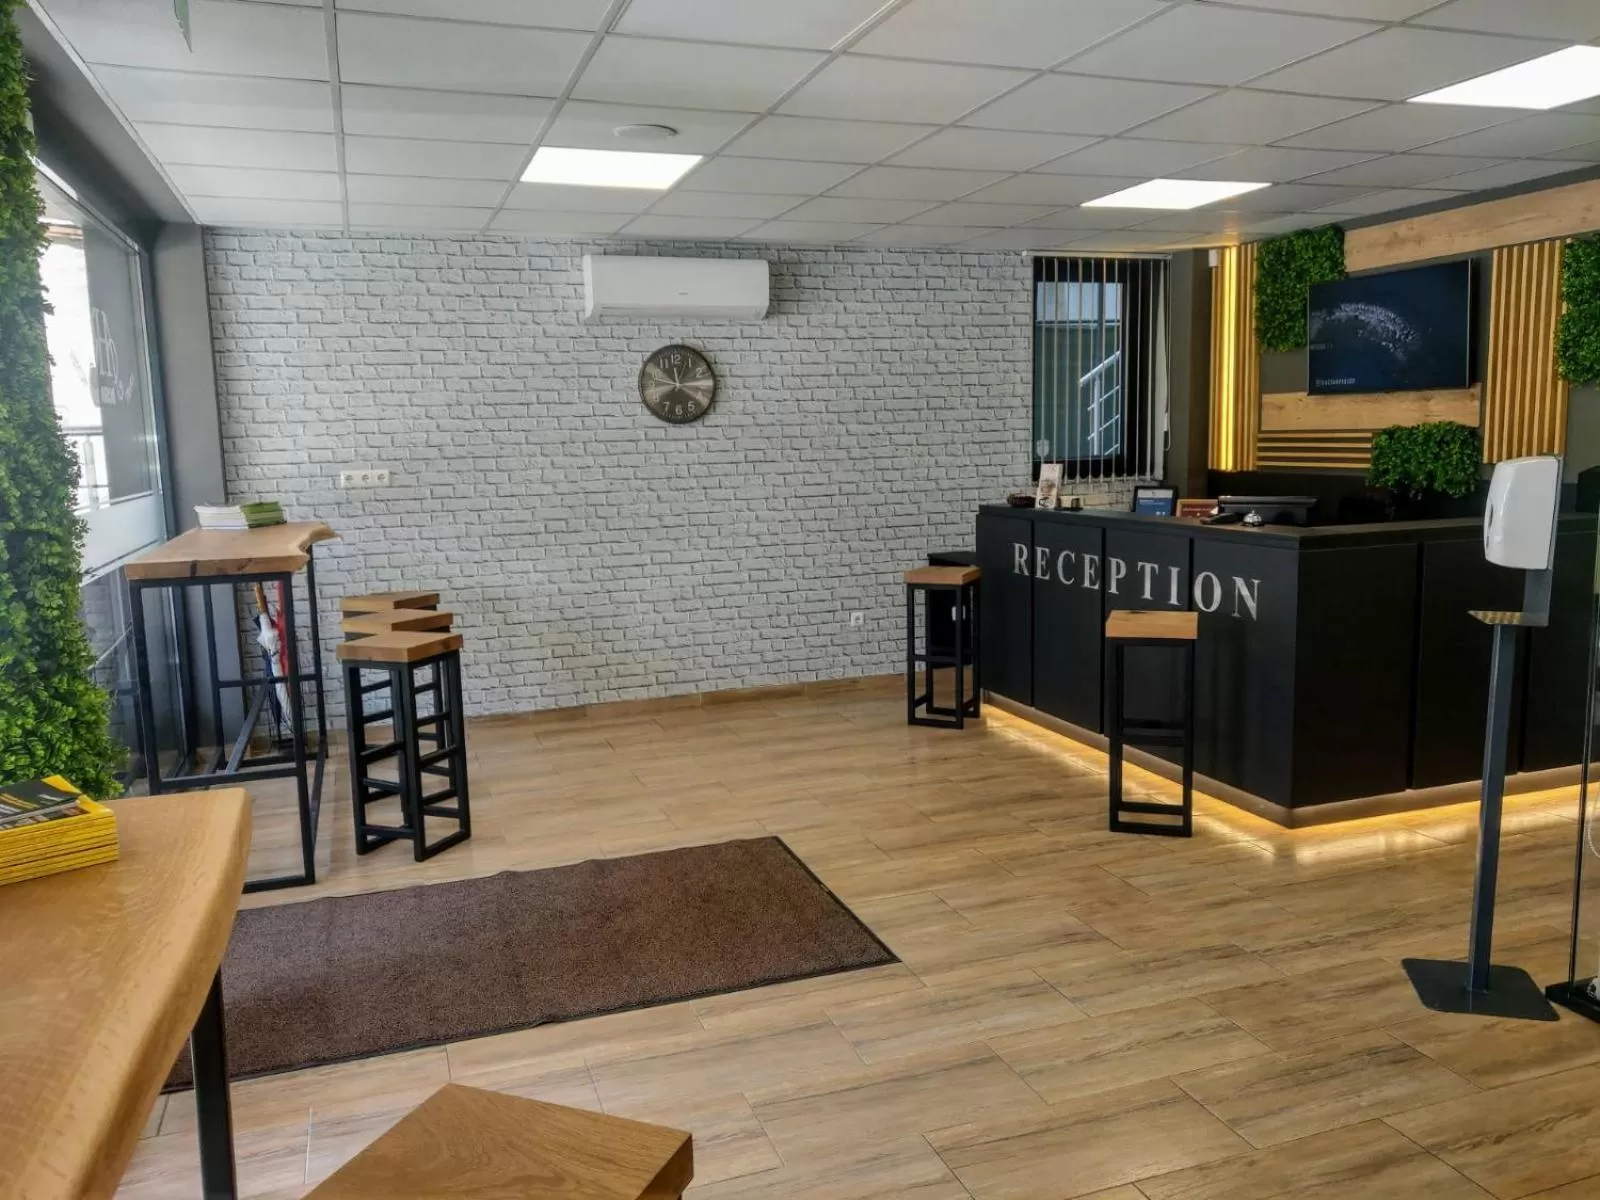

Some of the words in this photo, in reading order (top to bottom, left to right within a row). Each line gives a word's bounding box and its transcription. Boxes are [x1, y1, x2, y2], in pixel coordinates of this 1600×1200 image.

[660, 358, 669, 369] 11
[671, 354, 681, 365] 12
[695, 368, 703, 378] 2
[663, 401, 670, 412] 7
[675, 405, 682, 415] 6
[687, 401, 696, 412] 5
[1013, 543, 1261, 621] RECEPTION
